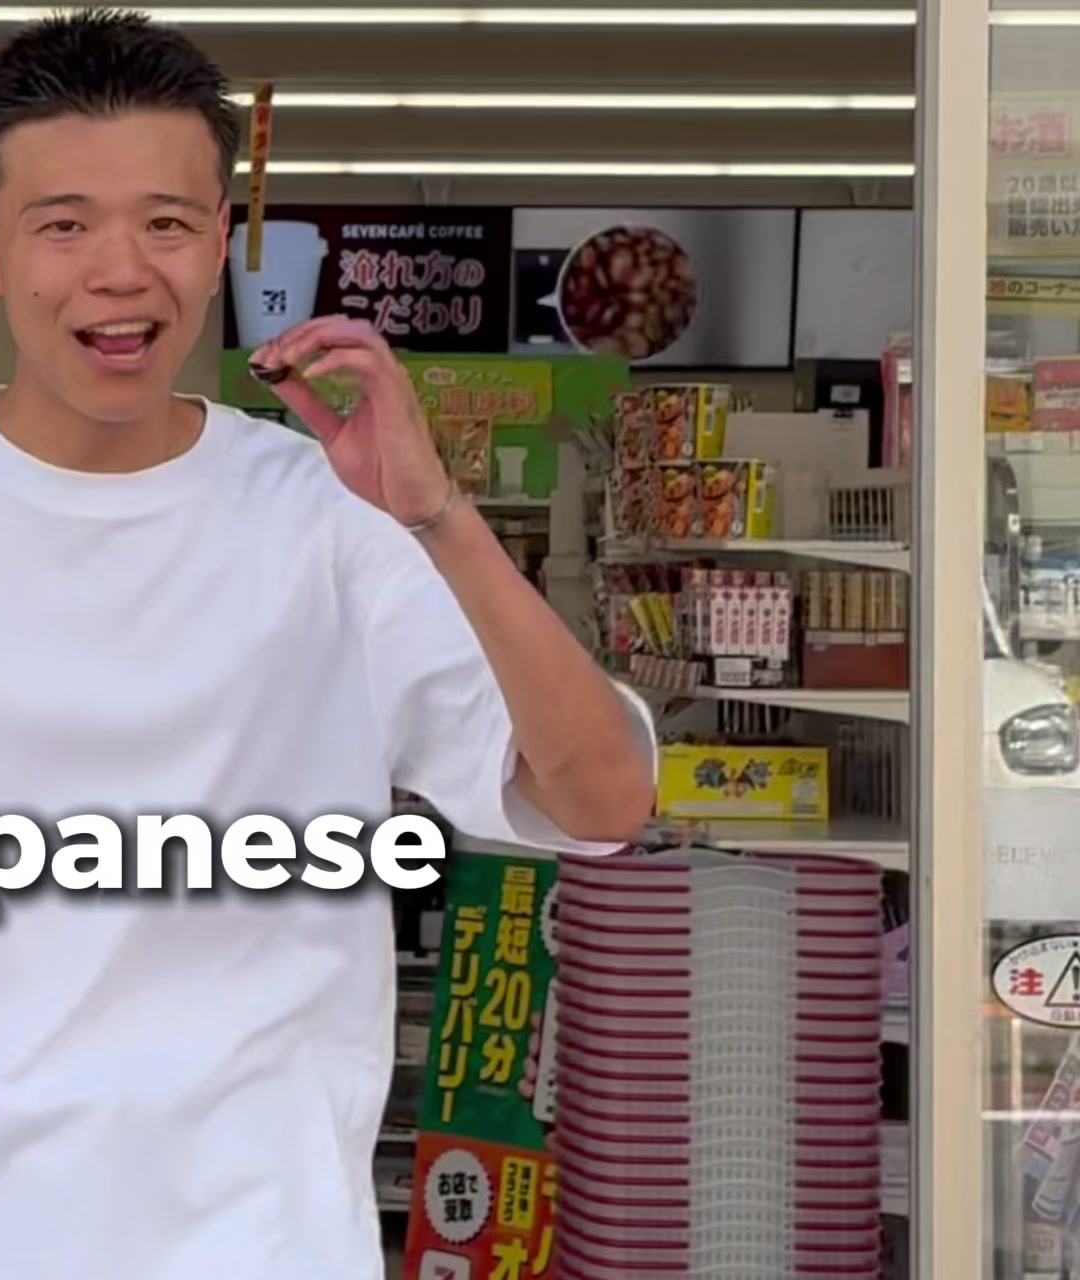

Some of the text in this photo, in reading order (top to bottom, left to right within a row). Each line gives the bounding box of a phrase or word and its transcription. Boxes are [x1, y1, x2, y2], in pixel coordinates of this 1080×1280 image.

[342, 223, 387, 239] SEVEN
[428, 225, 483, 239] COFFEE
[338, 248, 486, 291] 淹れ方の
[479, 866, 536, 1084] 最短20分
[1010, 968, 1044, 996] 注
[437, 906, 487, 1123] デリバリー
[438, 1172, 480, 1195] お店で
